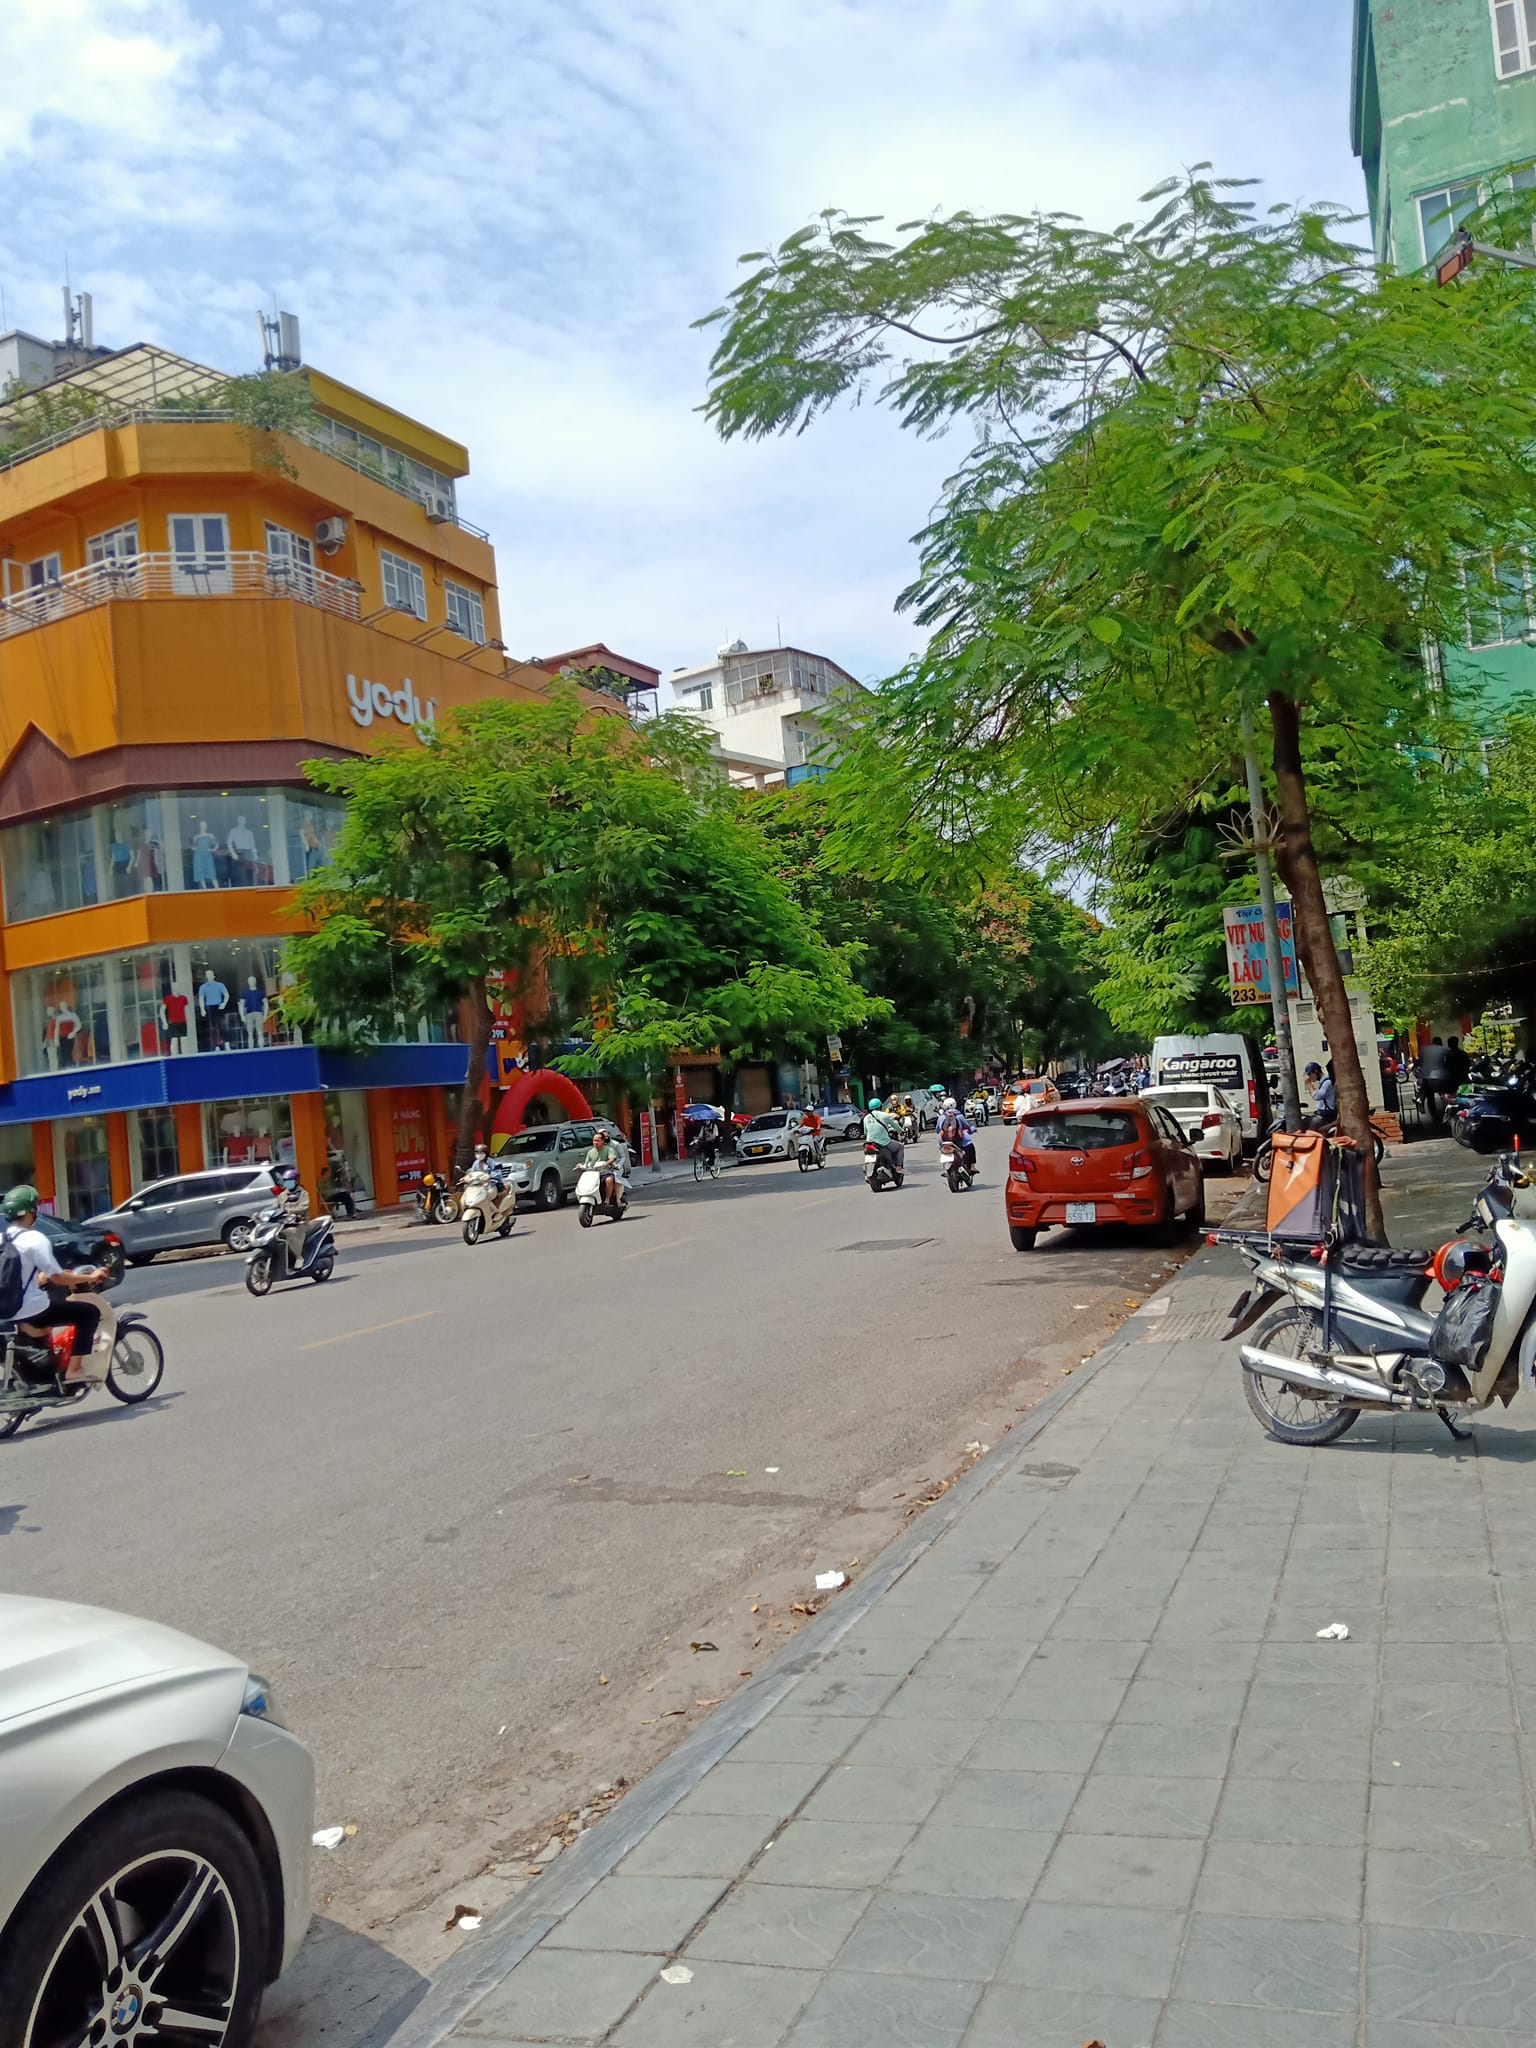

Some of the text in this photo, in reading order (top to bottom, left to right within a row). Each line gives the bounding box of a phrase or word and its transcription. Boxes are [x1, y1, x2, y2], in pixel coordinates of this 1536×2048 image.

[346, 673, 435, 746] yody
[1227, 924, 1246, 950] VỊT
[1233, 988, 1256, 1003] 233
[1159, 1058, 1237, 1072] Kangaroo
